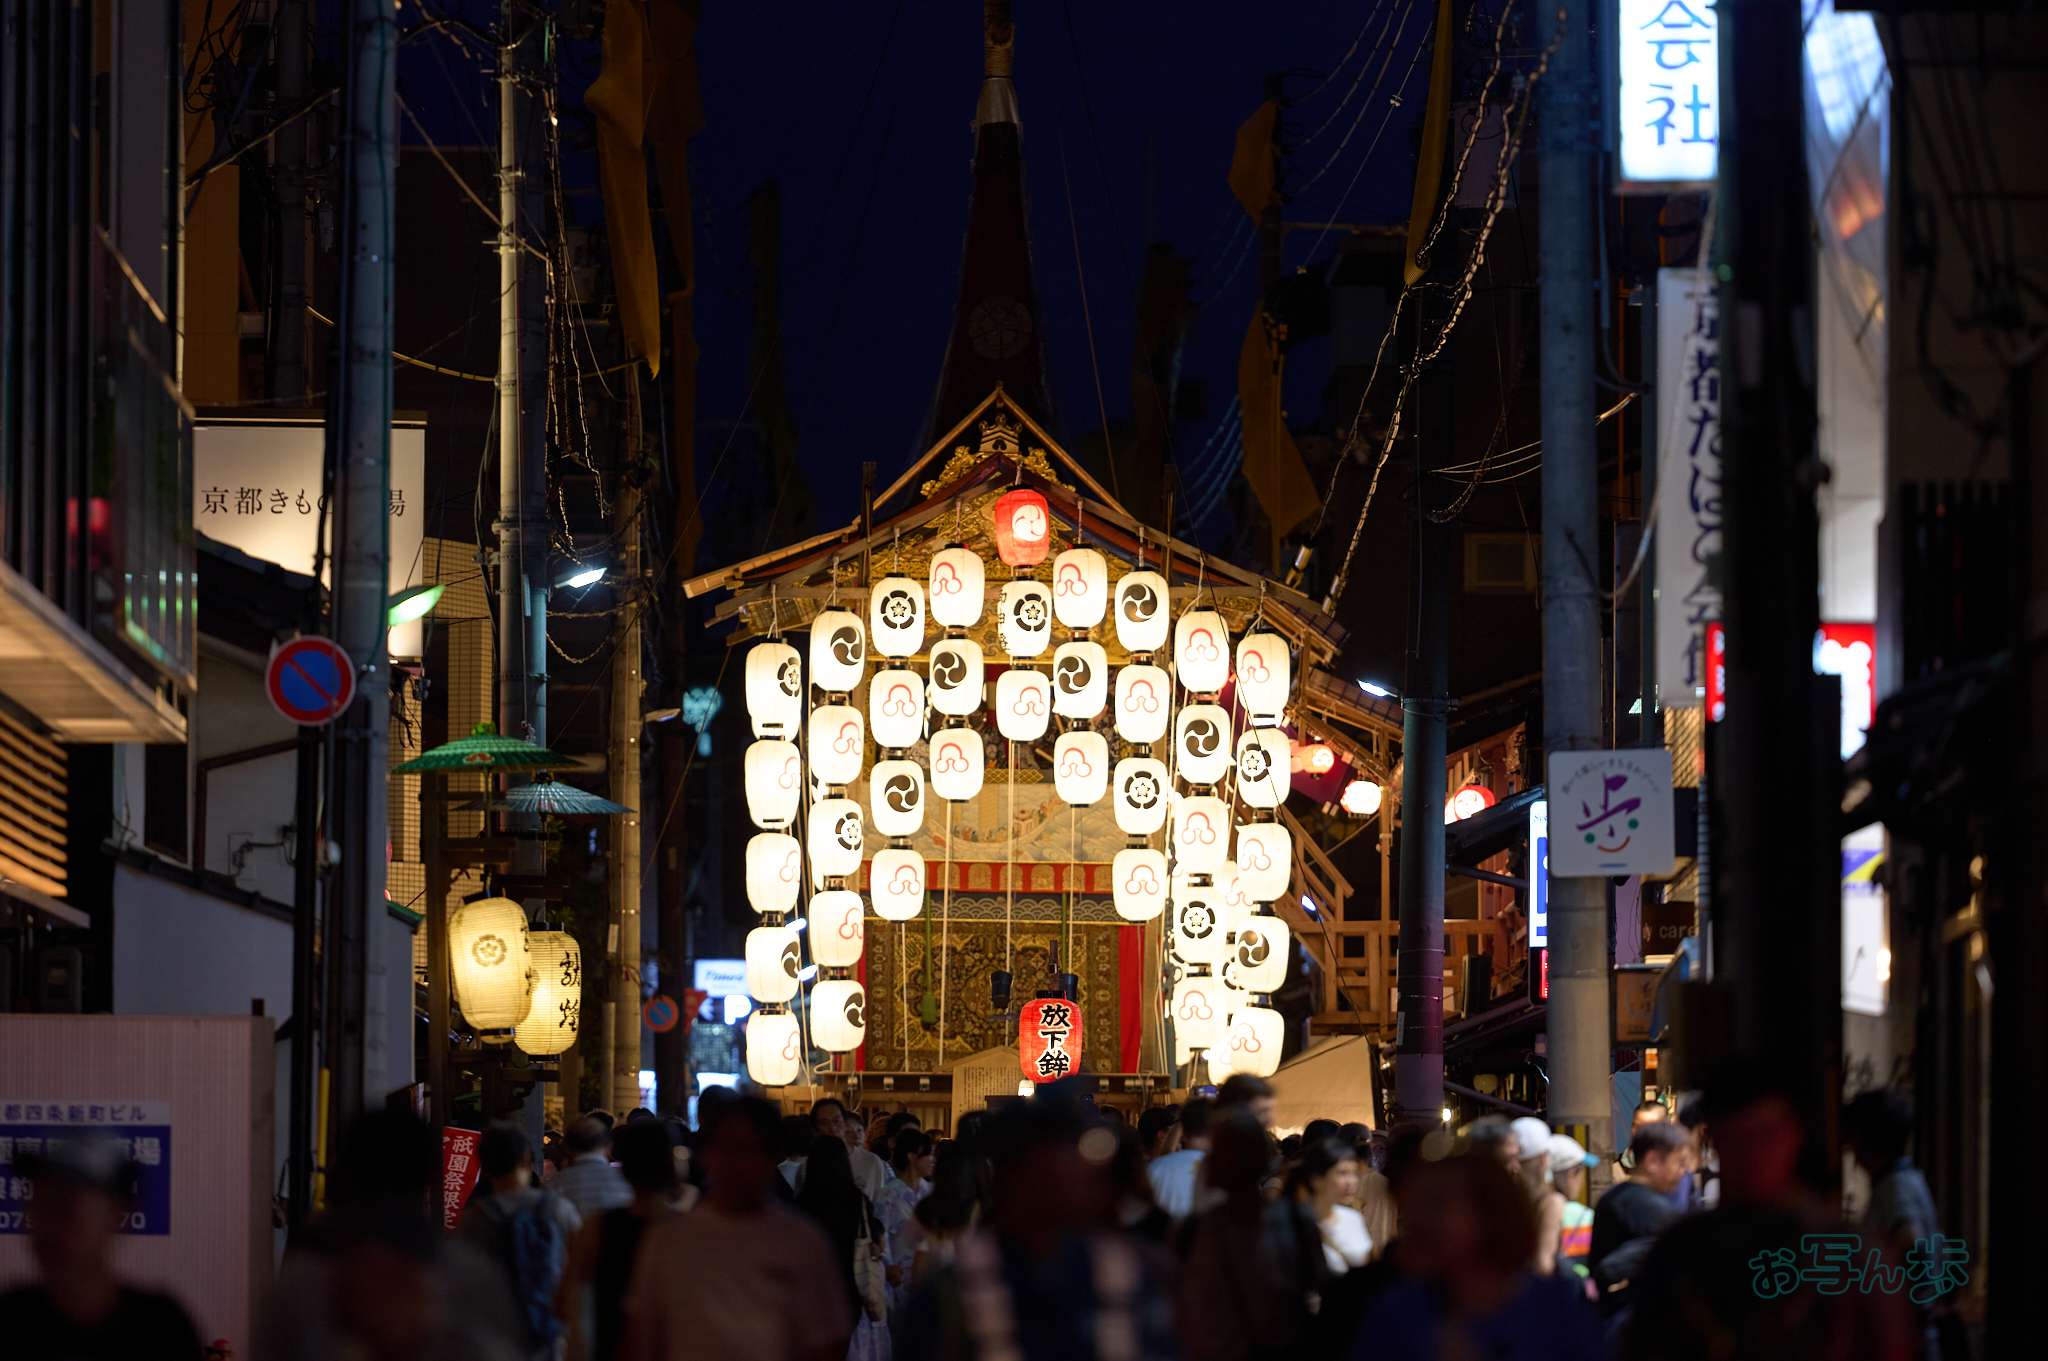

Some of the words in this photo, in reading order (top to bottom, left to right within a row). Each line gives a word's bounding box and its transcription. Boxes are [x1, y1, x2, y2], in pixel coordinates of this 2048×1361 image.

[1640, 0, 1715, 146] 会社
[1037, 1004, 1071, 1078] 放下鉾
